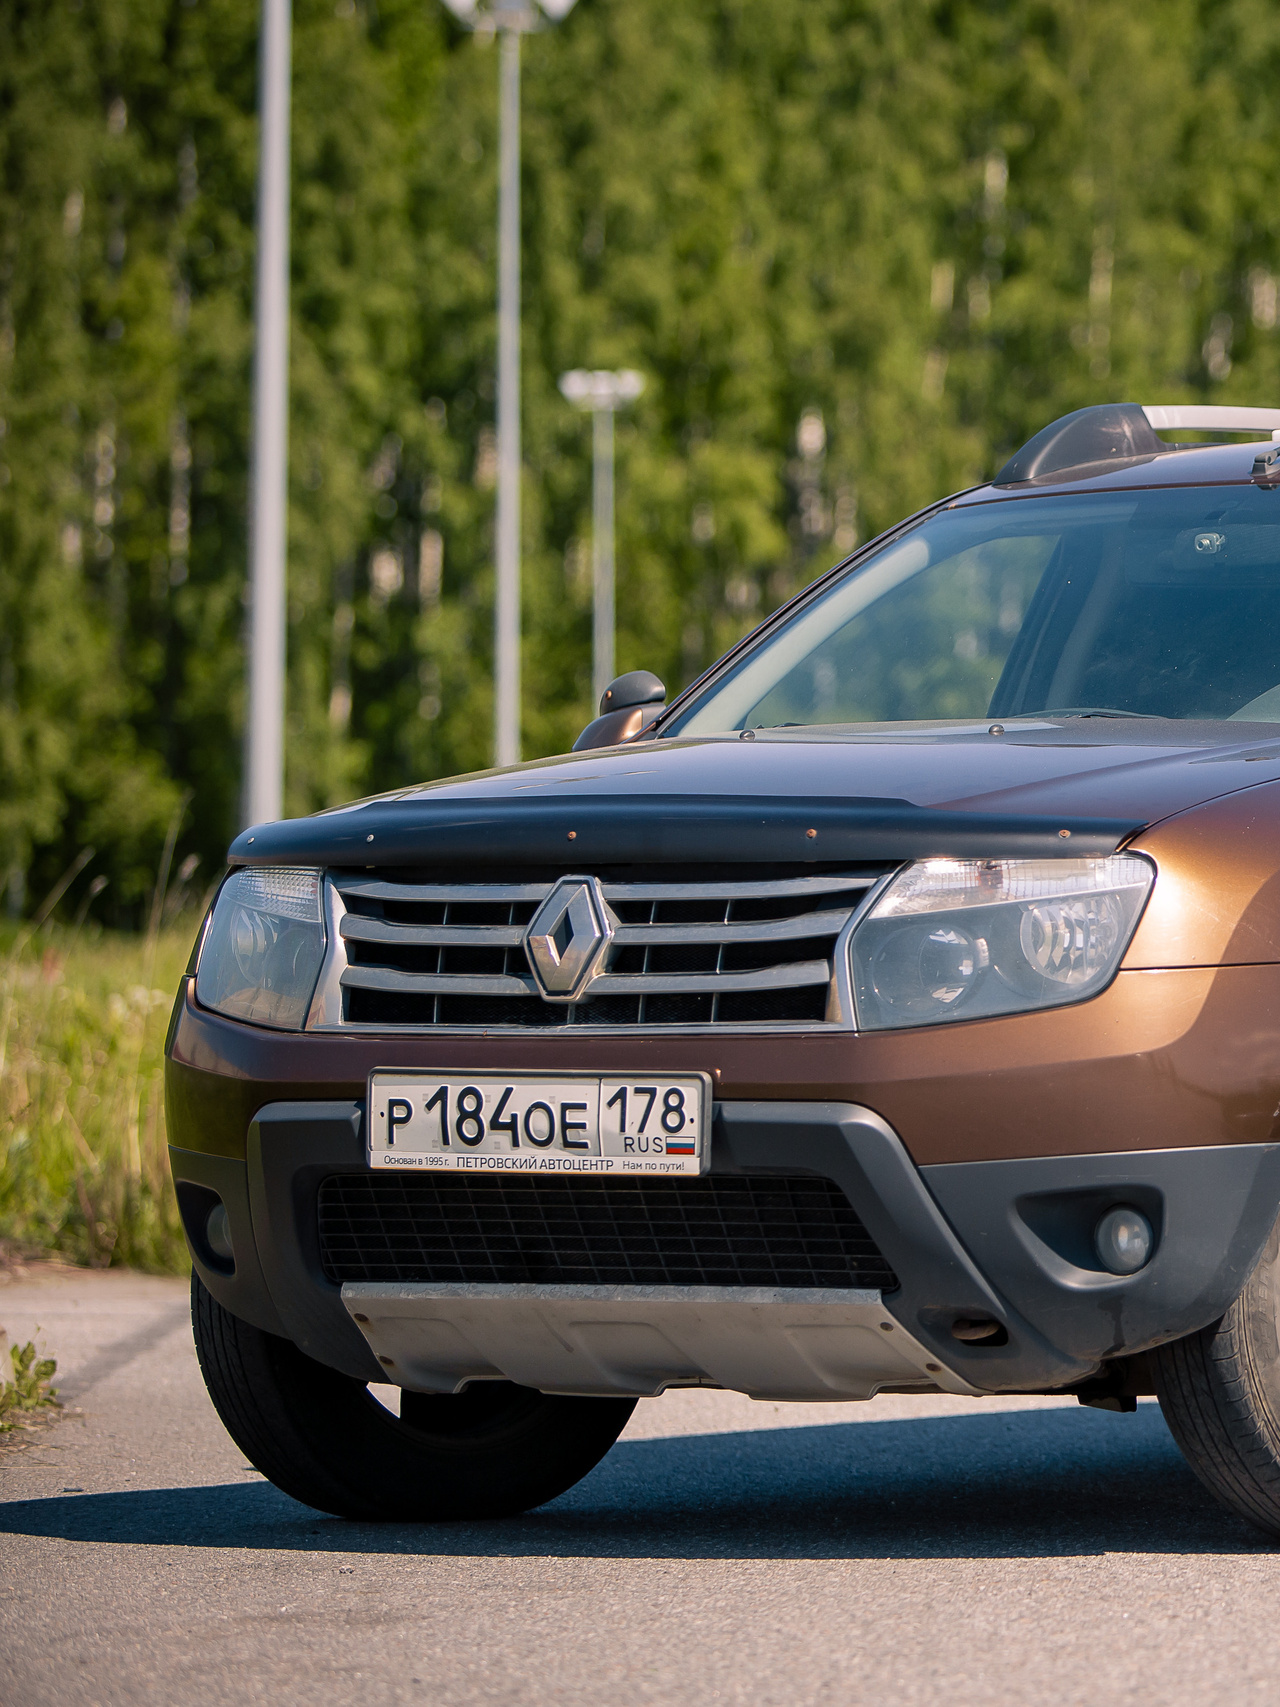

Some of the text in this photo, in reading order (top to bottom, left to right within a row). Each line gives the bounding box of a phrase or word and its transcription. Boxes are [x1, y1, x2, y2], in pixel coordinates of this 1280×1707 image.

[606, 1086, 687, 1134] 178
[623, 1136, 664, 1154] RUS
[383, 1154, 685, 1173] Основан в 1995 г. ПЕТРОВСКИЙ АВТОЦЕНТР Нам по пути!
